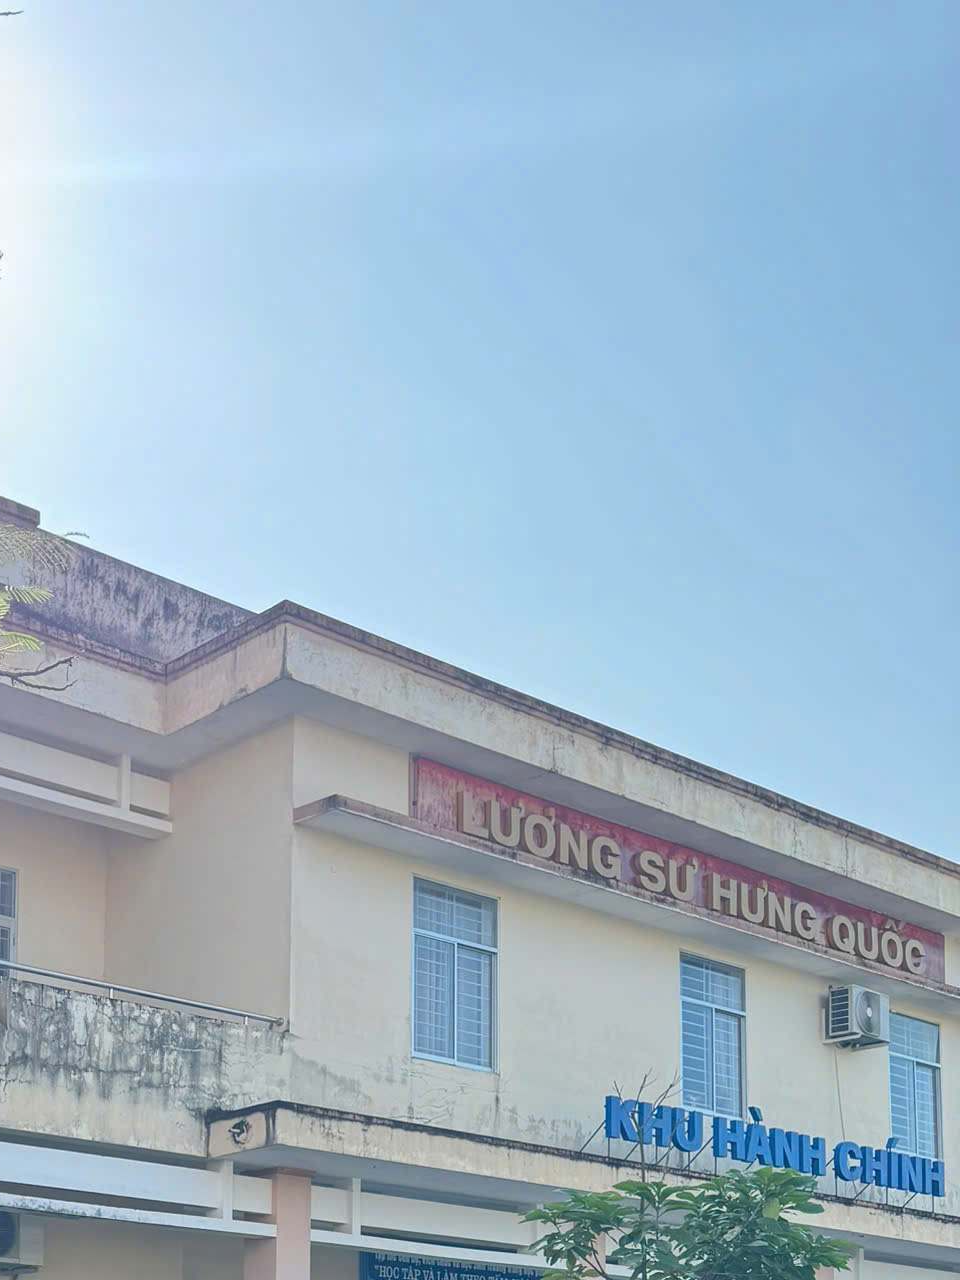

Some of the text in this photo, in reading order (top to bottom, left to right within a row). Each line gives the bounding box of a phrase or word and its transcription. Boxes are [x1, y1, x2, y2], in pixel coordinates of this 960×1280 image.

[457, 790, 928, 975] LƯƠNG SƯ HƯNG QUỐC
[605, 1095, 945, 1197] KHU HÀNH CHÍNH
